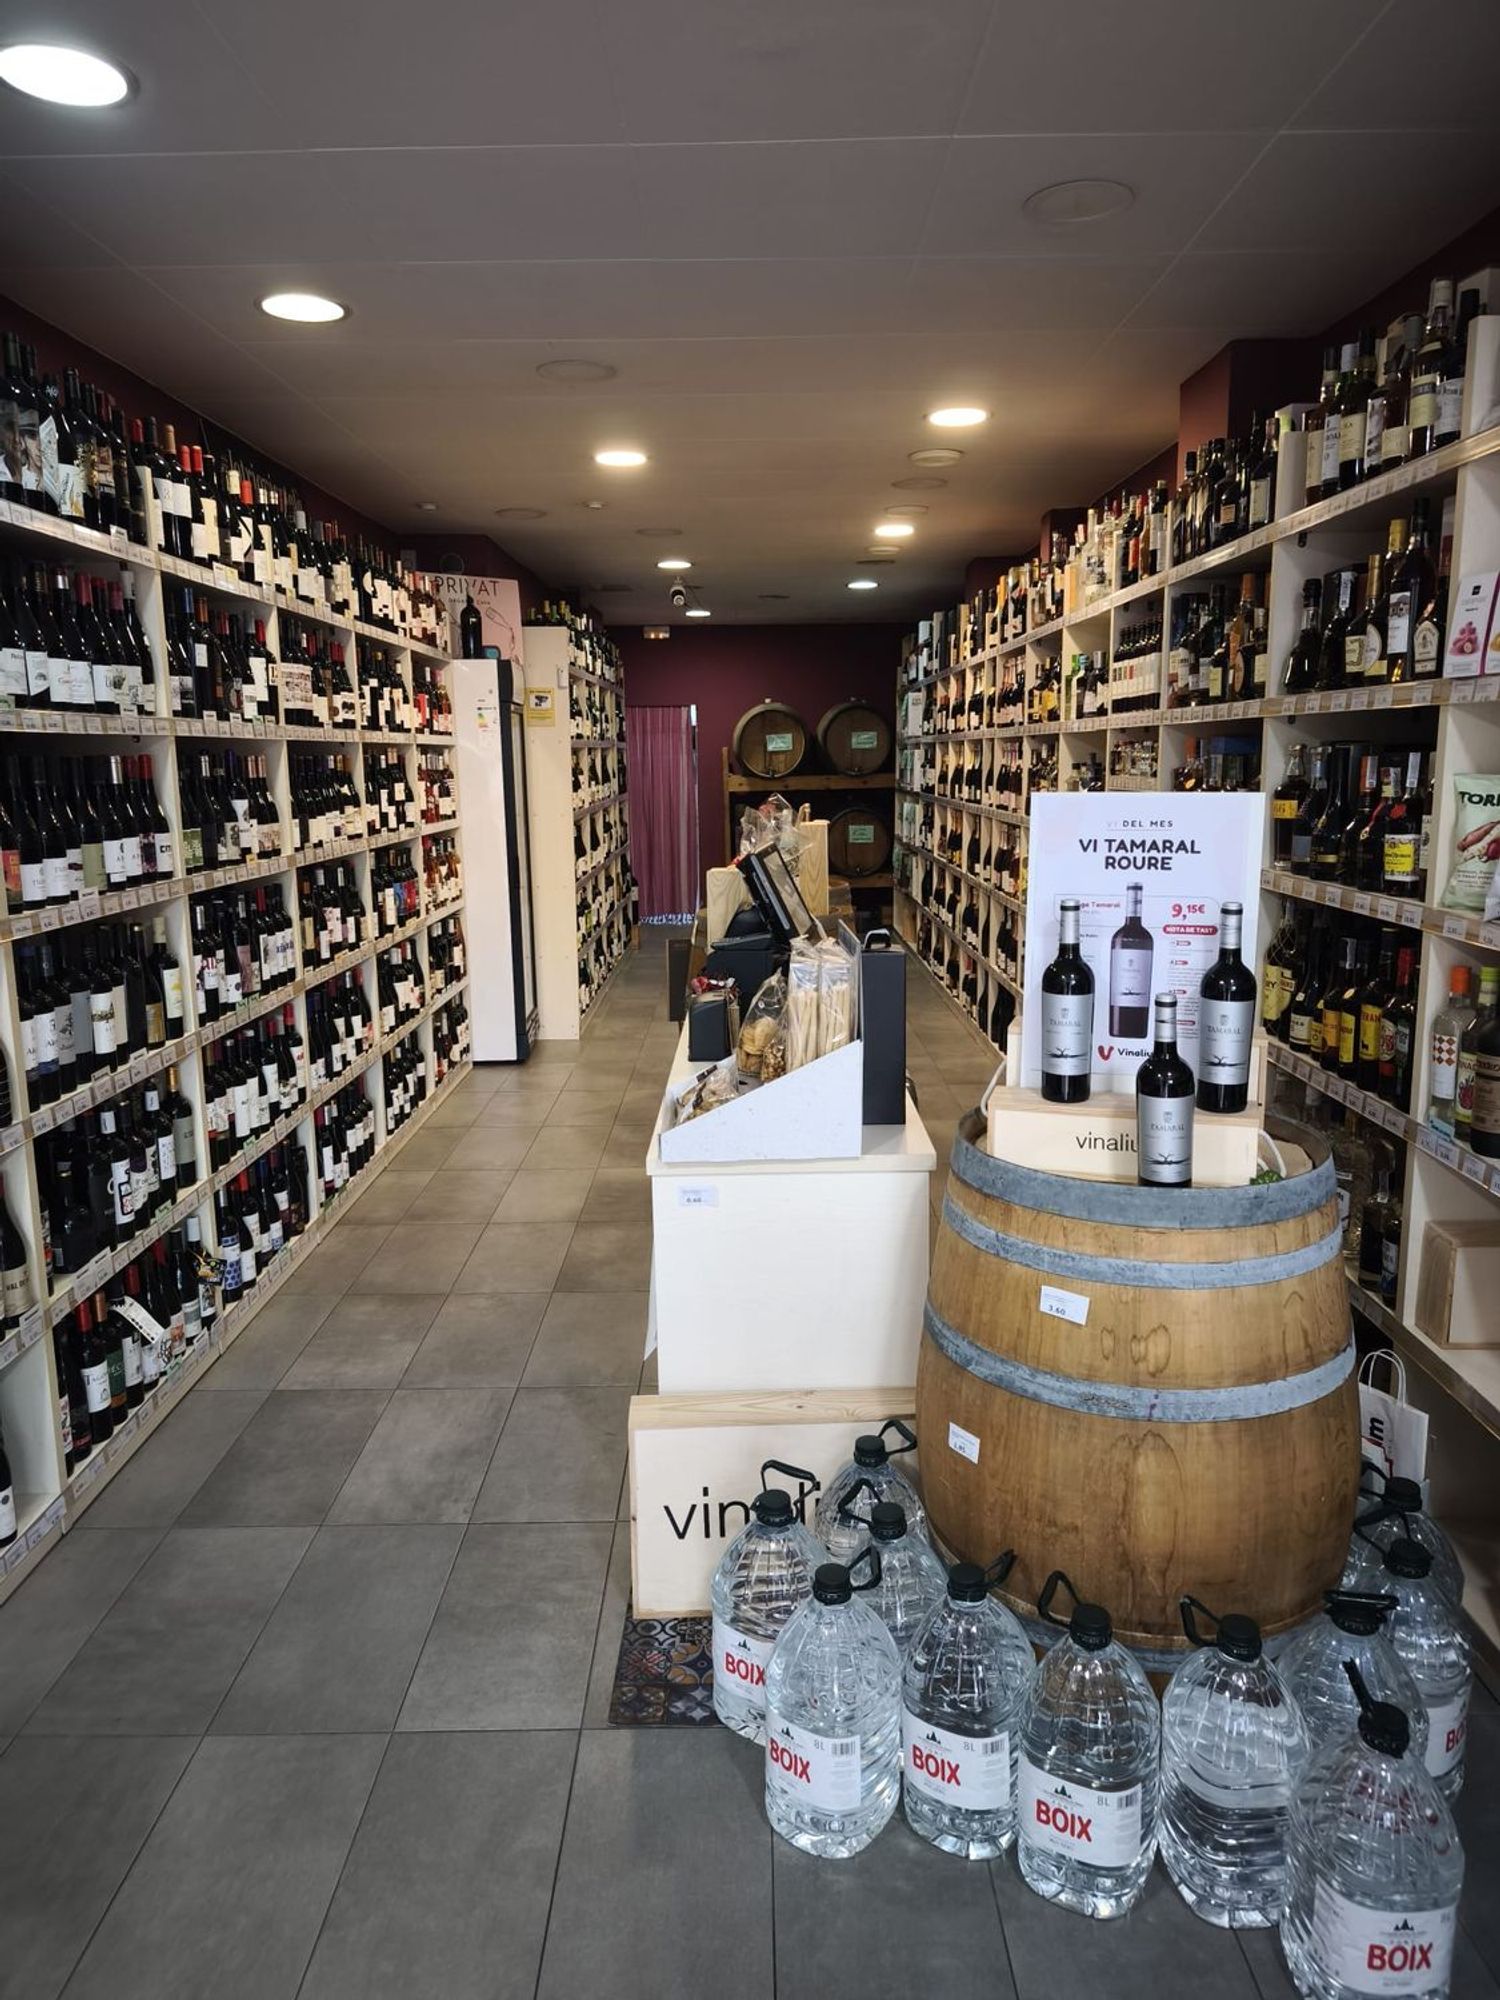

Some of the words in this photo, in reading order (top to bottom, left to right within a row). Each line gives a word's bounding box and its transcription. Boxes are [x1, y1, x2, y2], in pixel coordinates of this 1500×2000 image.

[434, 576, 499, 597] PRIVAT
[1122, 820, 1144, 828] DEL
[1150, 820, 1173, 828] MES
[1079, 838, 1098, 853] VI
[1104, 838, 1201, 854] TAMARAL
[1104, 856, 1173, 871] ROURE
[1172, 904, 1206, 921] 9,15€
[1050, 1019, 1081, 1028] TAMARAL
[1207, 1025, 1241, 1034] TAMARAL
[1150, 1124, 1184, 1132] TAMARAL
[725, 1652, 767, 1686] BOIX
[769, 1738, 811, 1783] BOIX
[912, 1744, 961, 1786] BOIX
[1036, 1798, 1092, 1843] BOIX
[1366, 1942, 1434, 1972] BOIX
